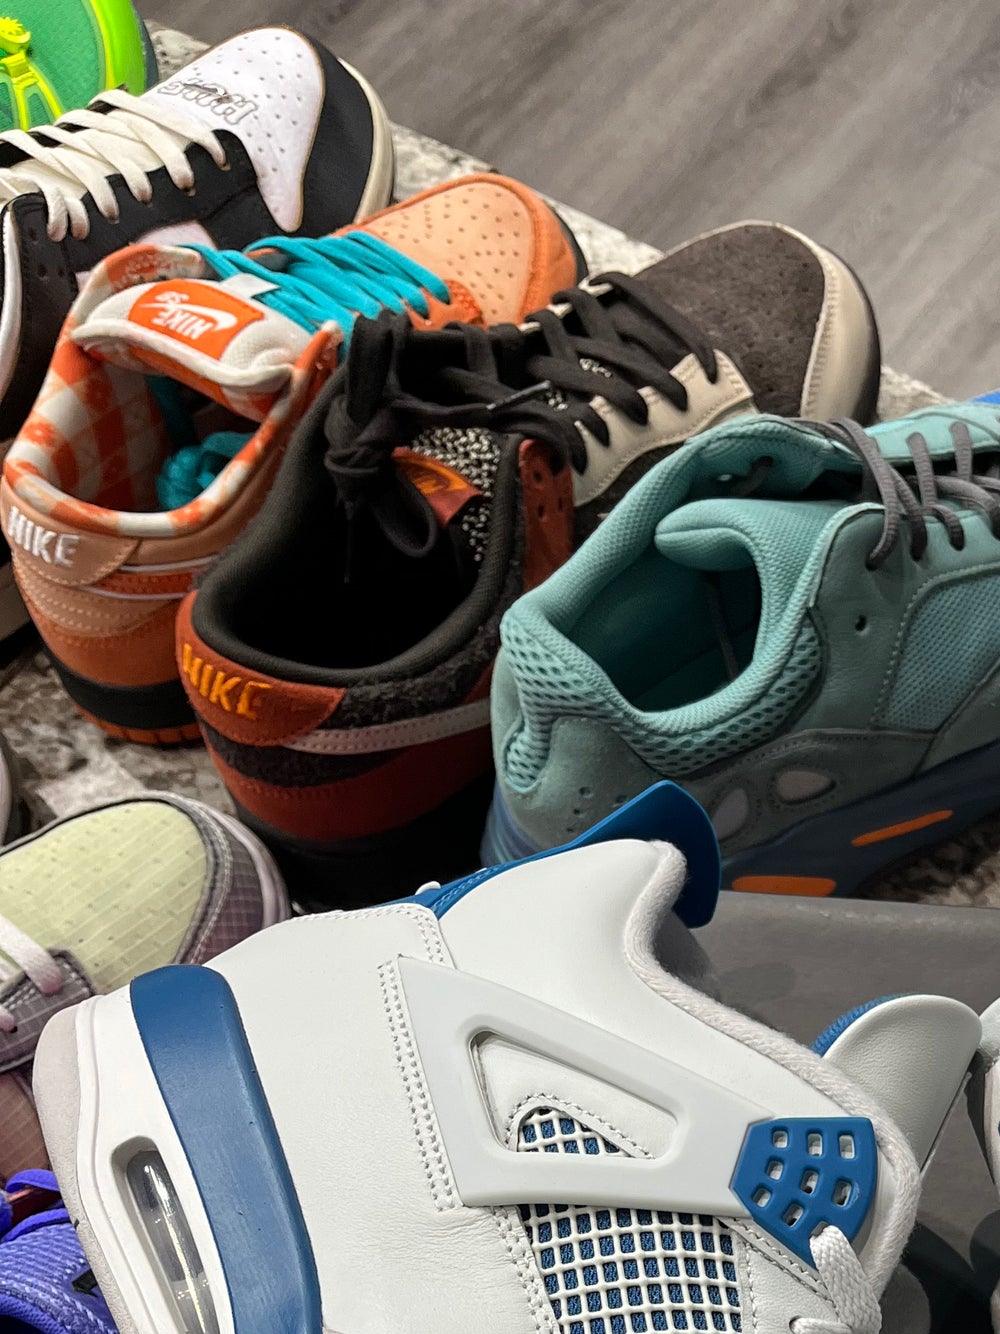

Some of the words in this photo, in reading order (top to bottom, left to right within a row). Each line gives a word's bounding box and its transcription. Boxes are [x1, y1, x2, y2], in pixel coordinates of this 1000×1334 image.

[151, 307, 214, 340] NIKE
[7, 505, 80, 568] NIKE
[182, 643, 273, 720] NIKE
